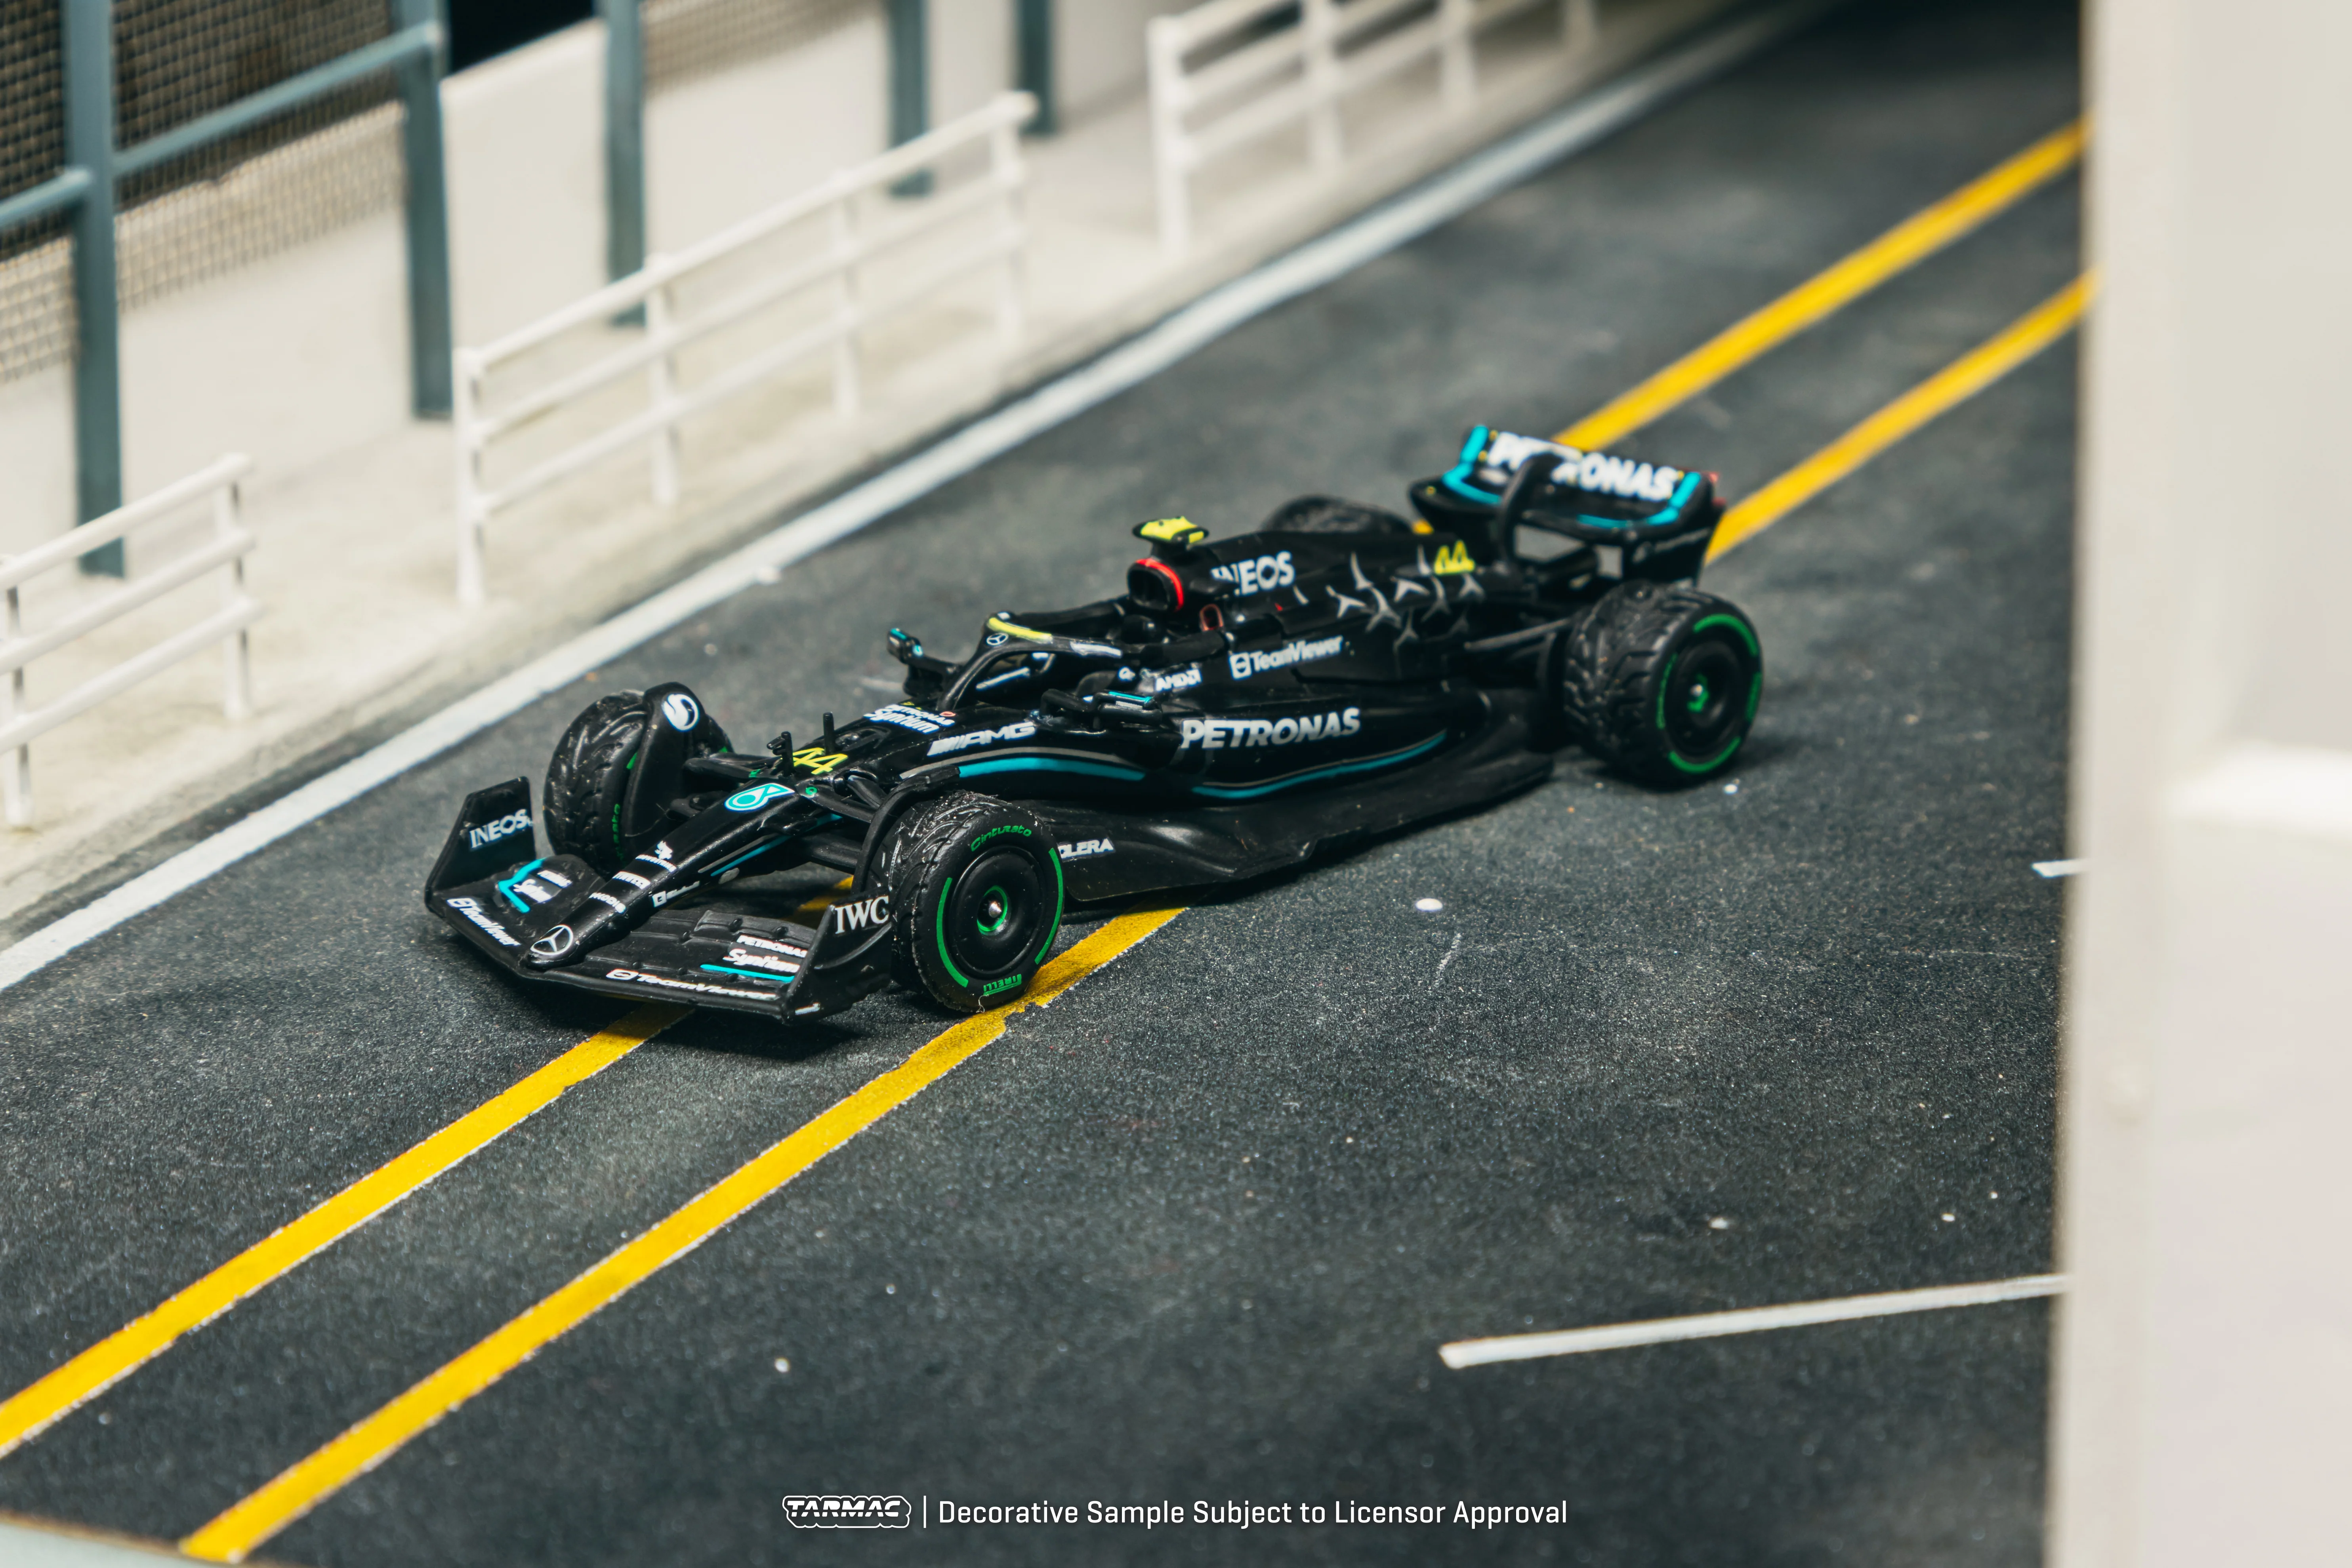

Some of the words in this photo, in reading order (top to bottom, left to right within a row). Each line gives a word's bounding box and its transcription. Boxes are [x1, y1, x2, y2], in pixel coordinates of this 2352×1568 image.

[1250, 635, 1343, 671] TeamViewer
[1180, 707, 1360, 748] PETRONAS
[470, 809, 527, 848] INEOS
[835, 895, 889, 934] IWC
[723, 948, 801, 973] Syntium
